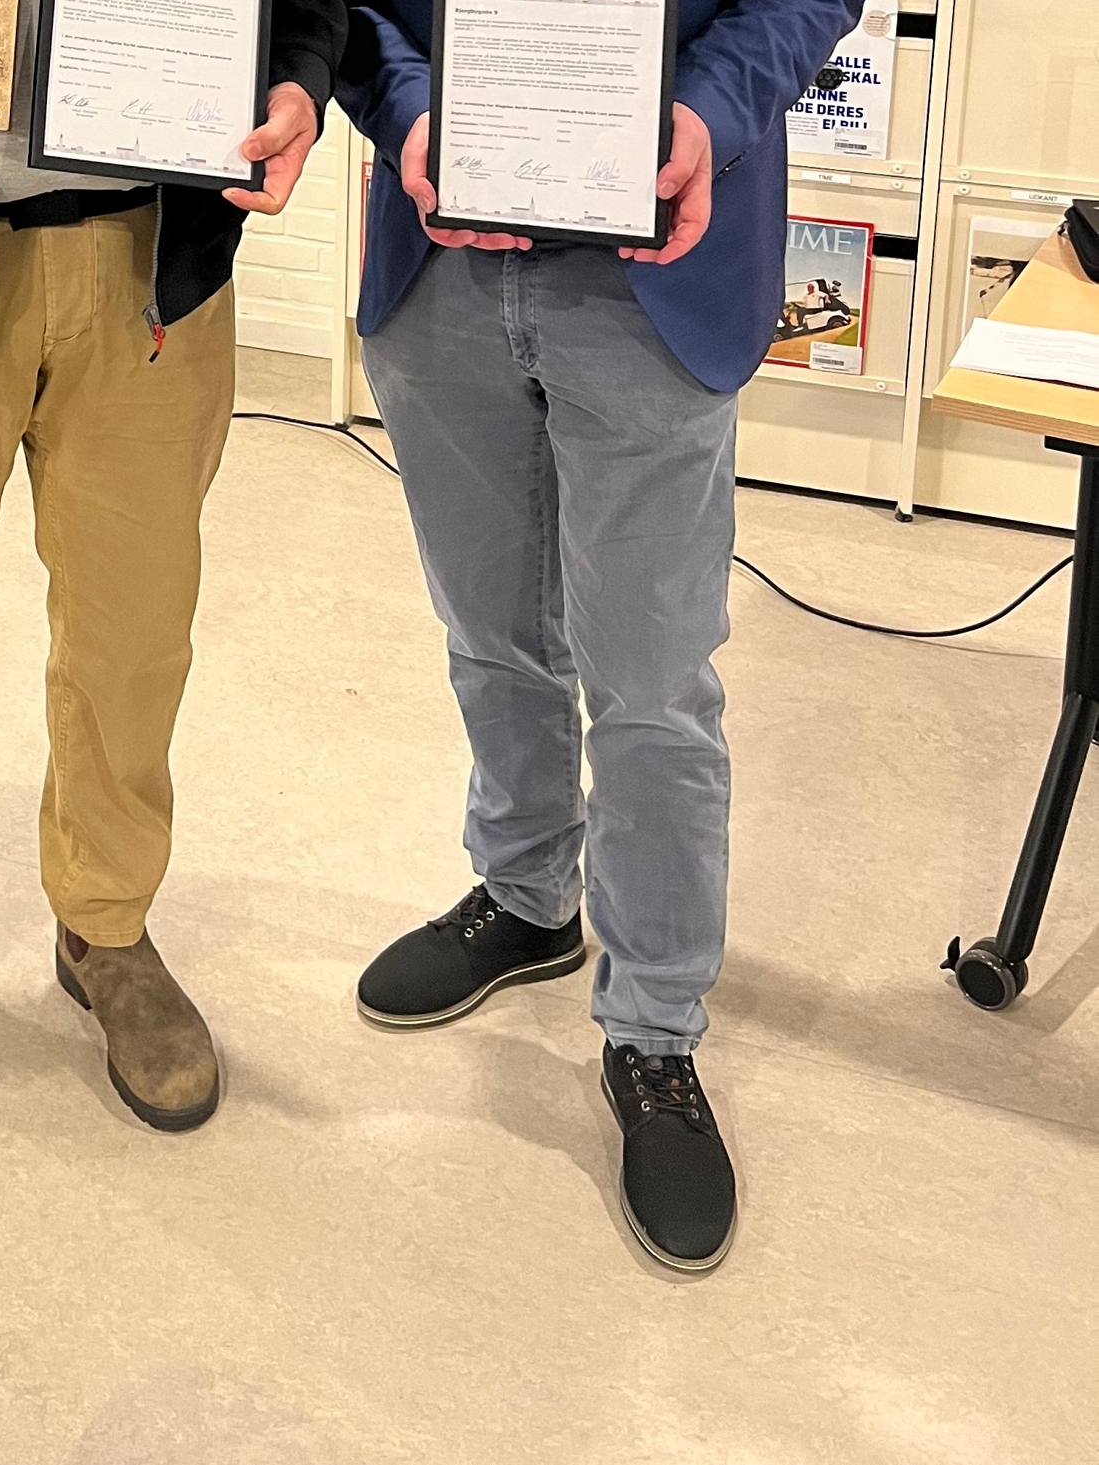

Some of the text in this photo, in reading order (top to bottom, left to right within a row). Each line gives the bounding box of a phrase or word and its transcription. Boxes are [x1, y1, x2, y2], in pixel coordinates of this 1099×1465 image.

[834, 55, 871, 70] ALLE
[841, 71, 881, 85] SKAL
[816, 103, 864, 118] DERES
[818, 174, 834, 182] TIME
[788, 223, 854, 255] IME
